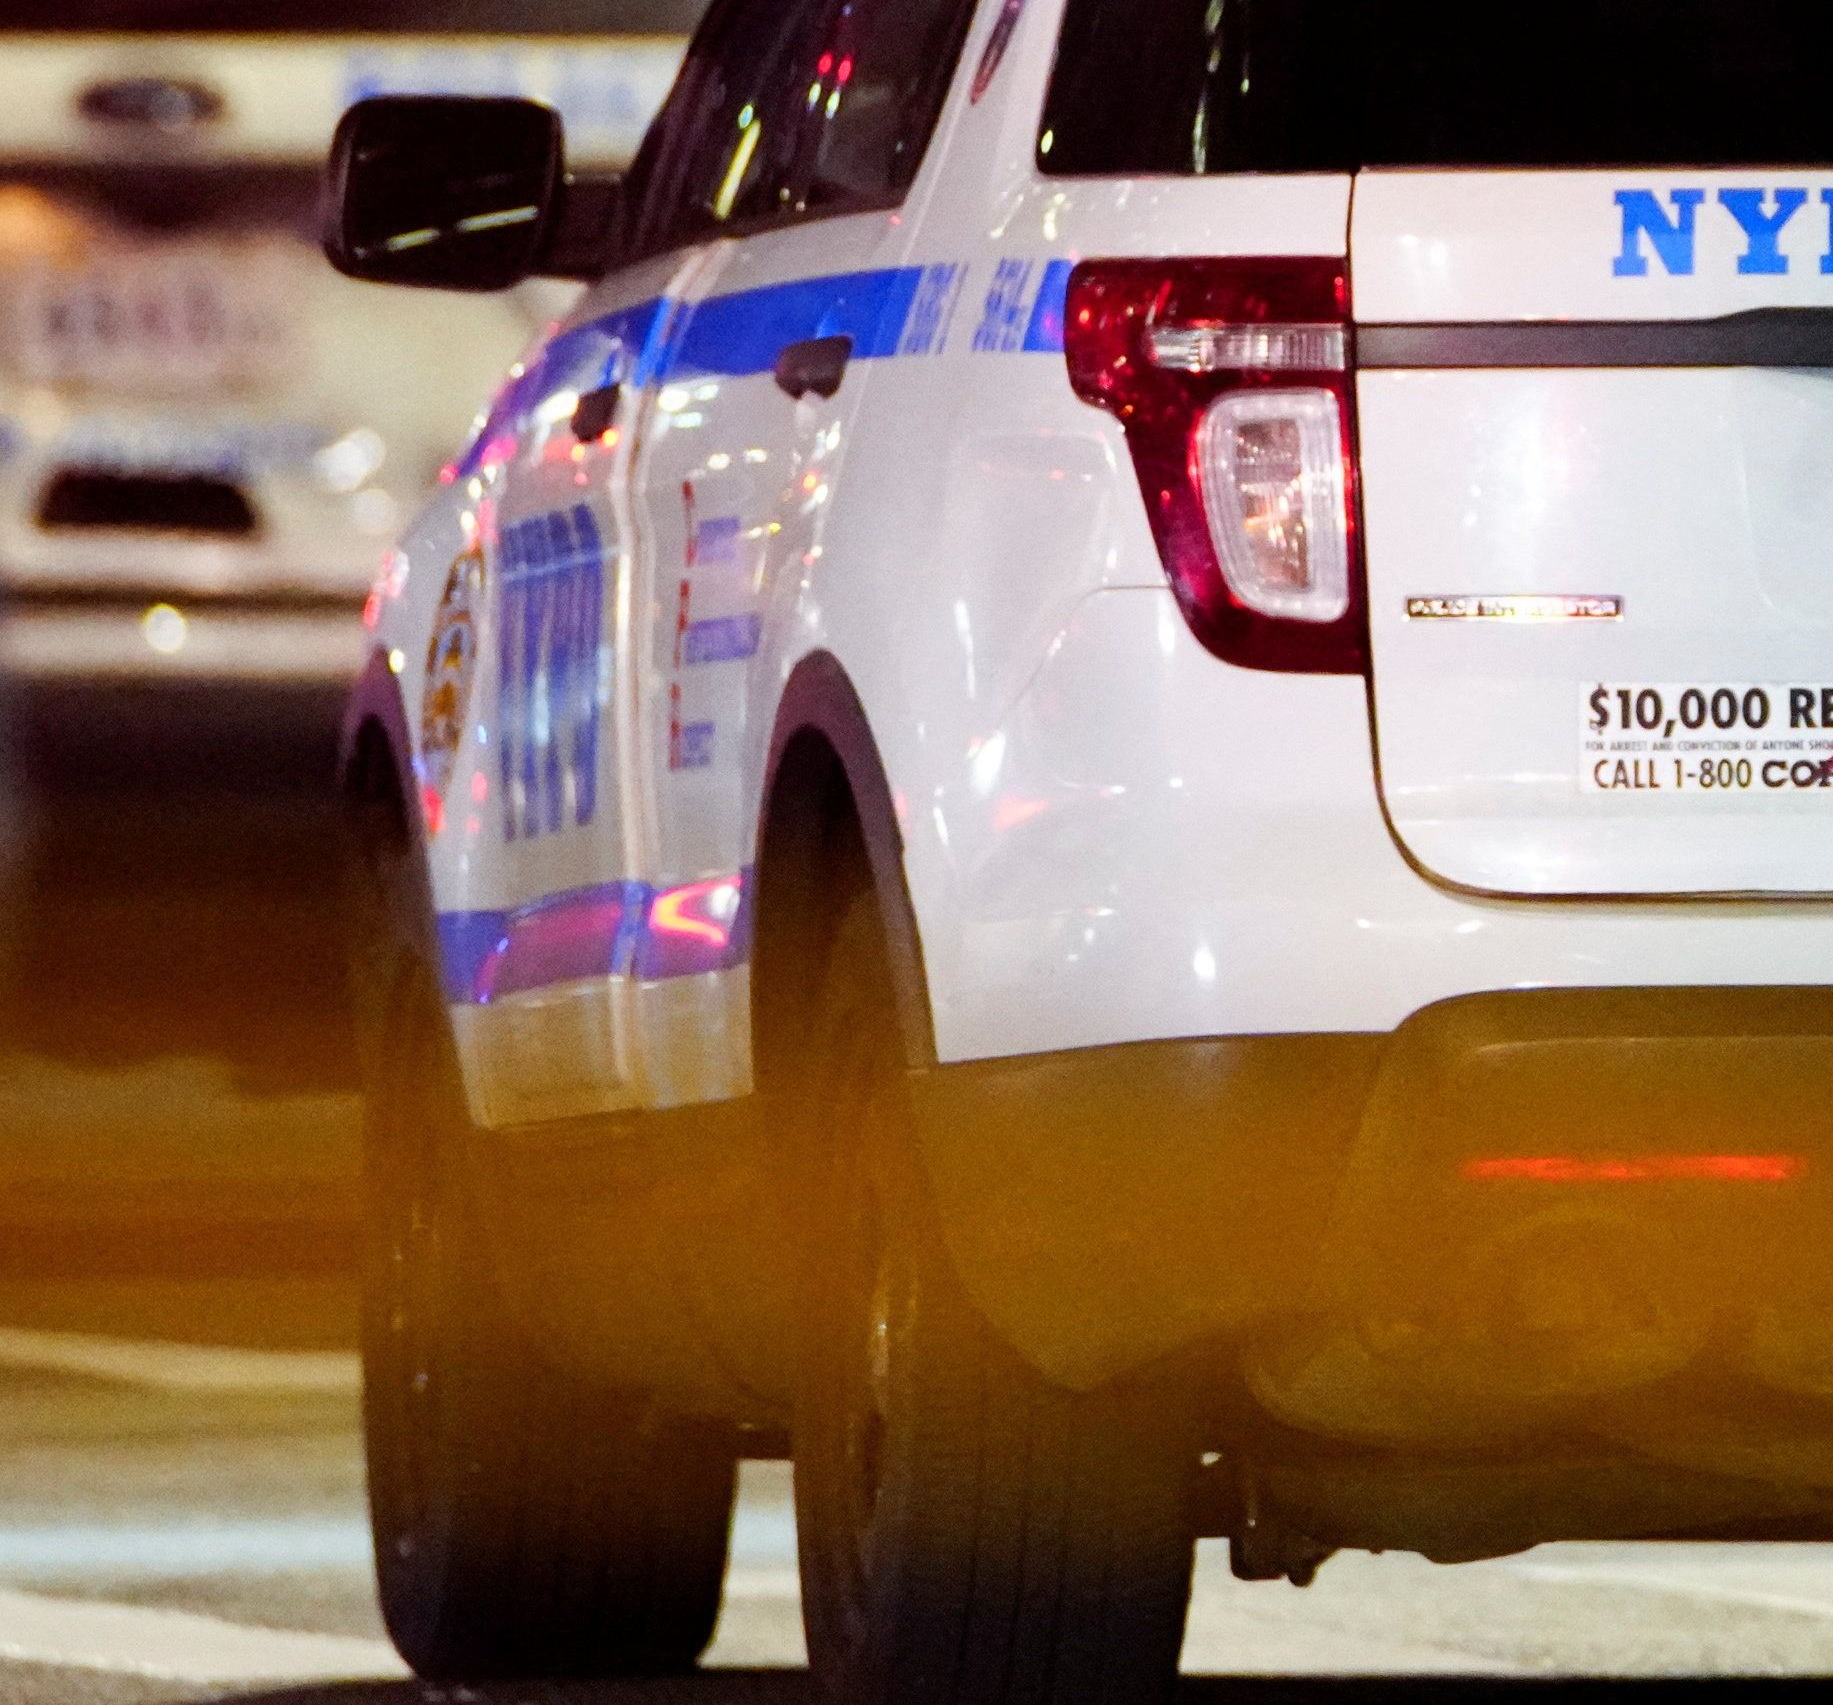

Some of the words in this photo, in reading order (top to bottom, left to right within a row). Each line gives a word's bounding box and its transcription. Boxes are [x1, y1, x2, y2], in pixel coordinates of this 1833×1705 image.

[1589, 682, 1771, 739] $10,000
[1594, 758, 1660, 789] CALL
[1674, 758, 1752, 788] 1-800
